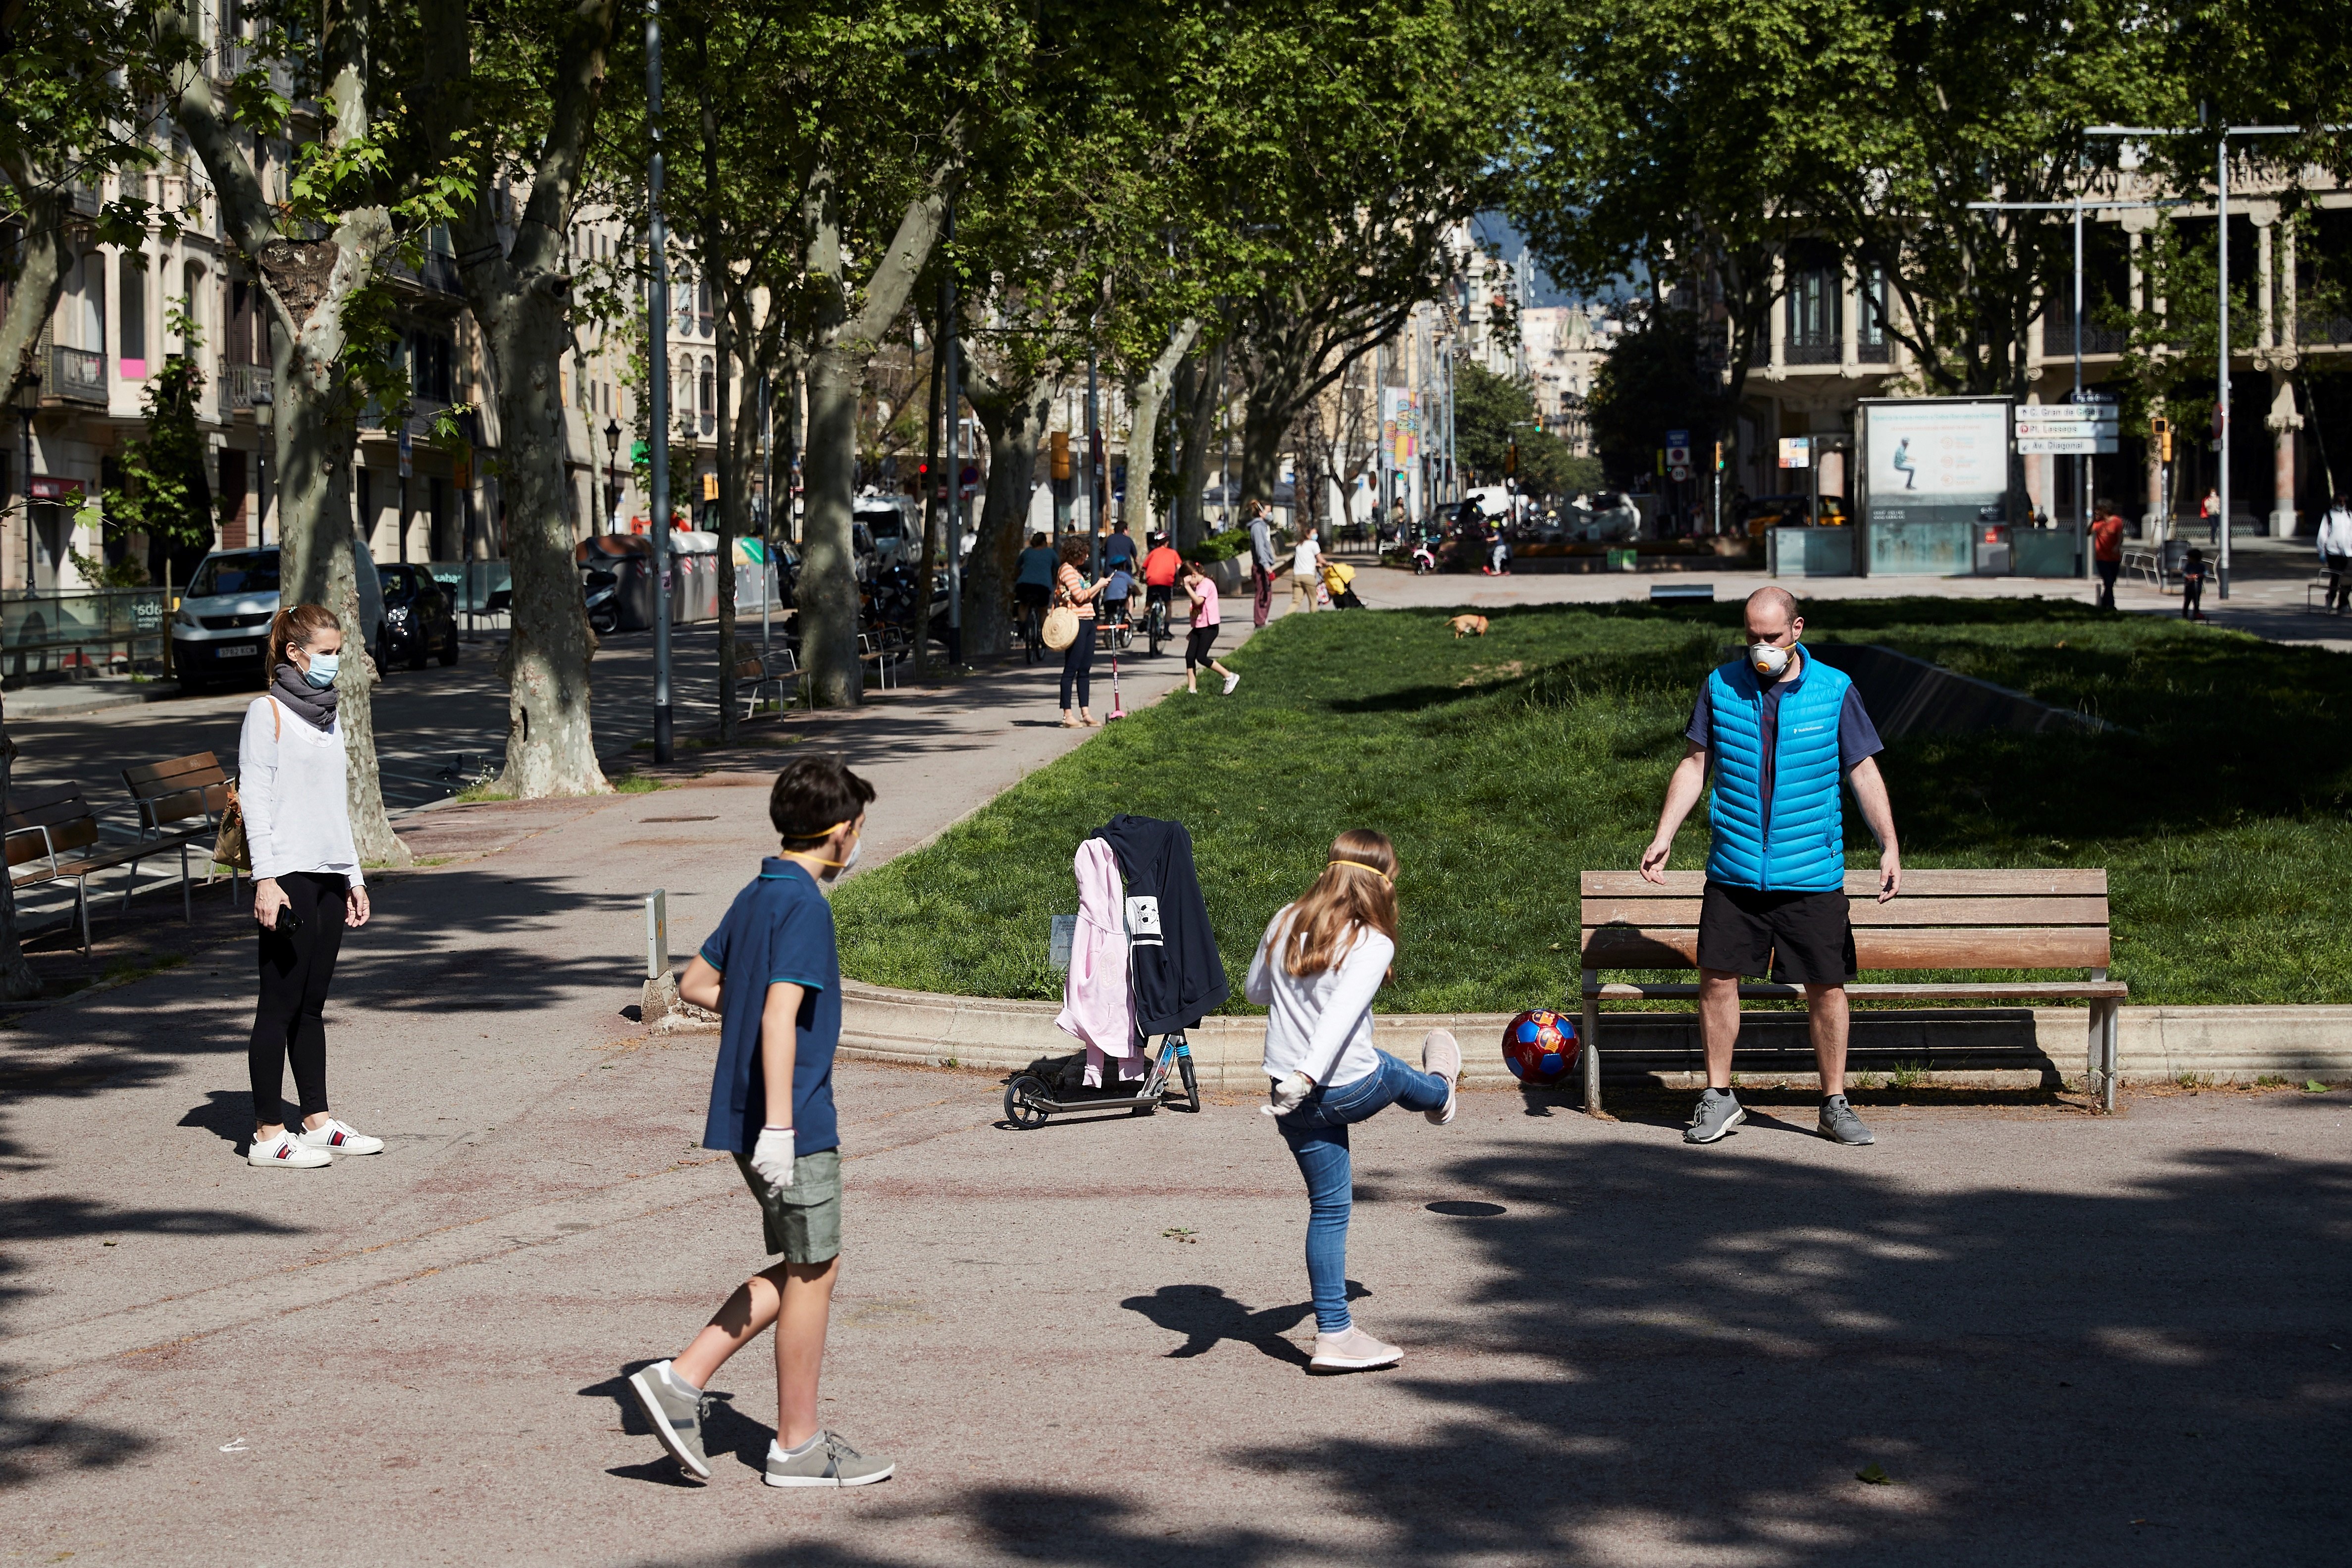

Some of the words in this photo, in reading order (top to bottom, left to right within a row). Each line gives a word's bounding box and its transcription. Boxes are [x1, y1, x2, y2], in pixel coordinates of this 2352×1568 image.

[2043, 425, 2077, 434] Lesseps
[2047, 442, 2083, 451] Diagonal
[433, 572, 458, 583] saba
